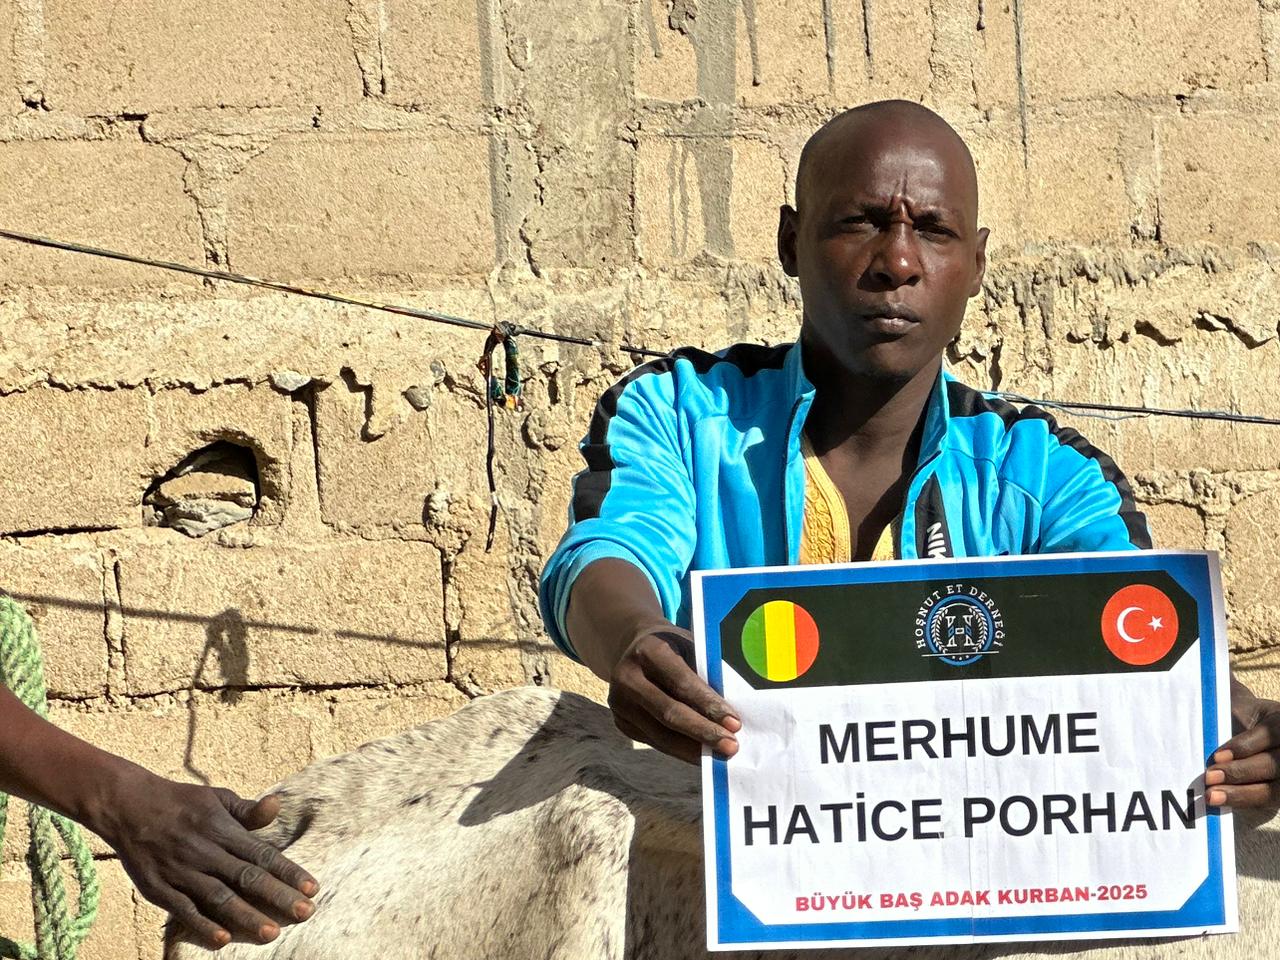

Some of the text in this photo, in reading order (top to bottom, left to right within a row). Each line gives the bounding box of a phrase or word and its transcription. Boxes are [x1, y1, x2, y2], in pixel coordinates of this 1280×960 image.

[915, 590, 941, 649] HOŞNUT
[946, 584, 963, 595] ET
[819, 712, 1100, 765] MERHUME
[743, 788, 1198, 846] HATİCE PORHAN
[795, 884, 1149, 912] BÜYÜK BAŞ ADAK KURBAN-2025
